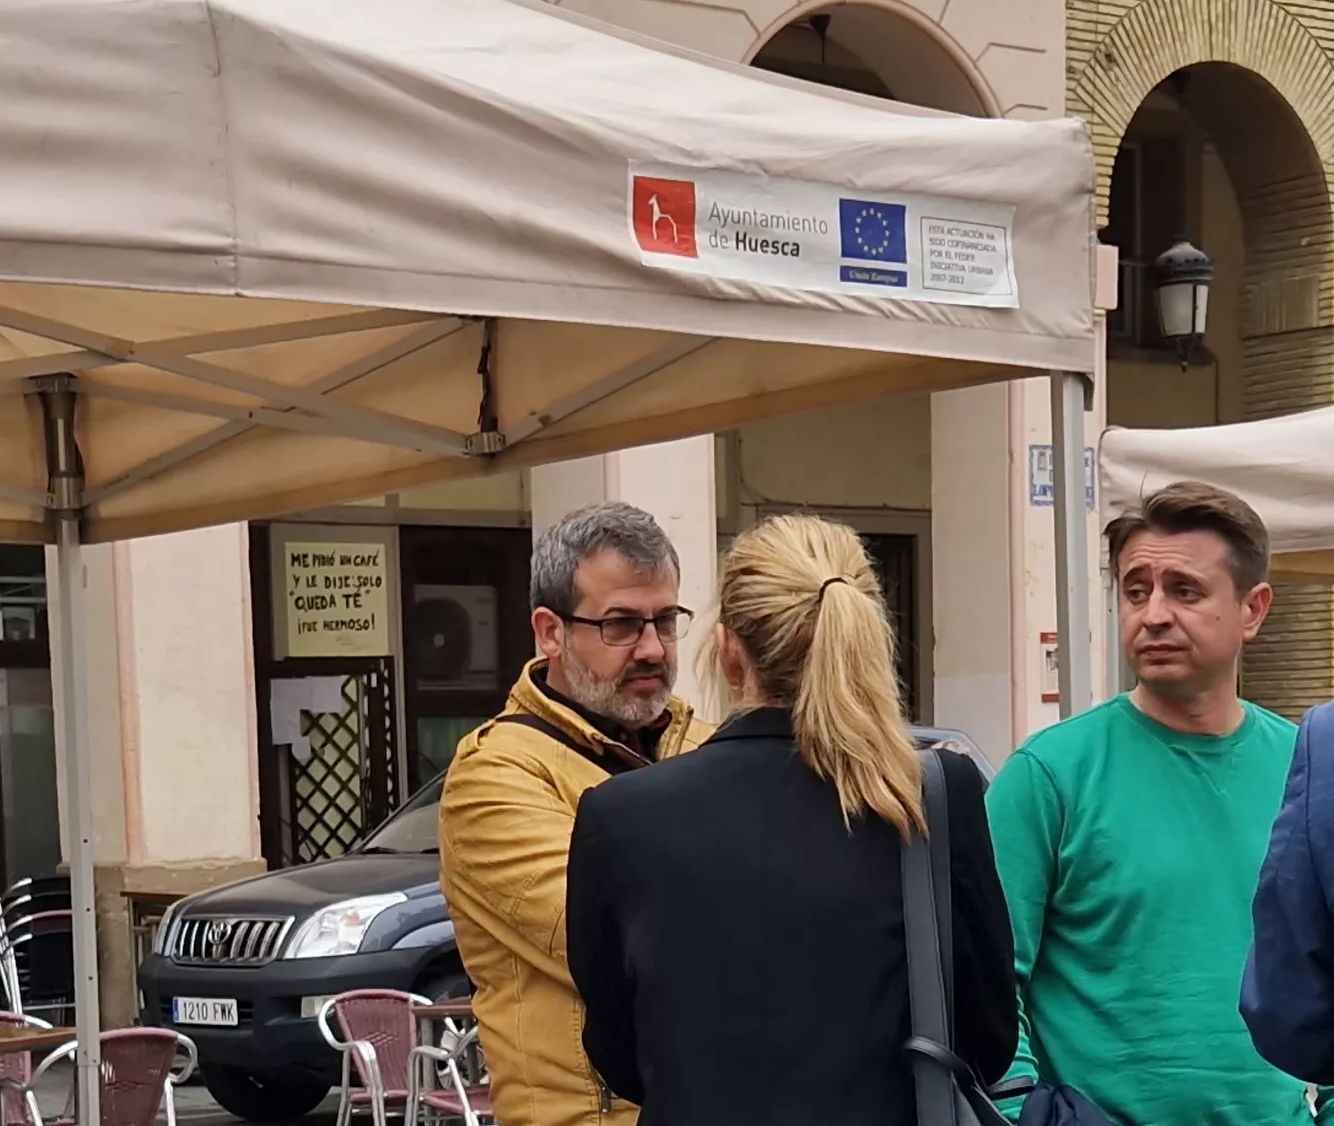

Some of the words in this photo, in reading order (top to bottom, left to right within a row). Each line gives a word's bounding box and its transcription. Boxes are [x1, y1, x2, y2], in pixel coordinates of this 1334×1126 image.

[708, 201, 828, 234] Ayuntamiento
[708, 229, 729, 249] de
[735, 230, 800, 257] Huesca
[291, 552, 310, 568] ME
[353, 549, 380, 567] CAFÉ
[293, 574, 301, 589] Y
[306, 574, 318, 588] LE
[183, 1002, 208, 1020] 1210
